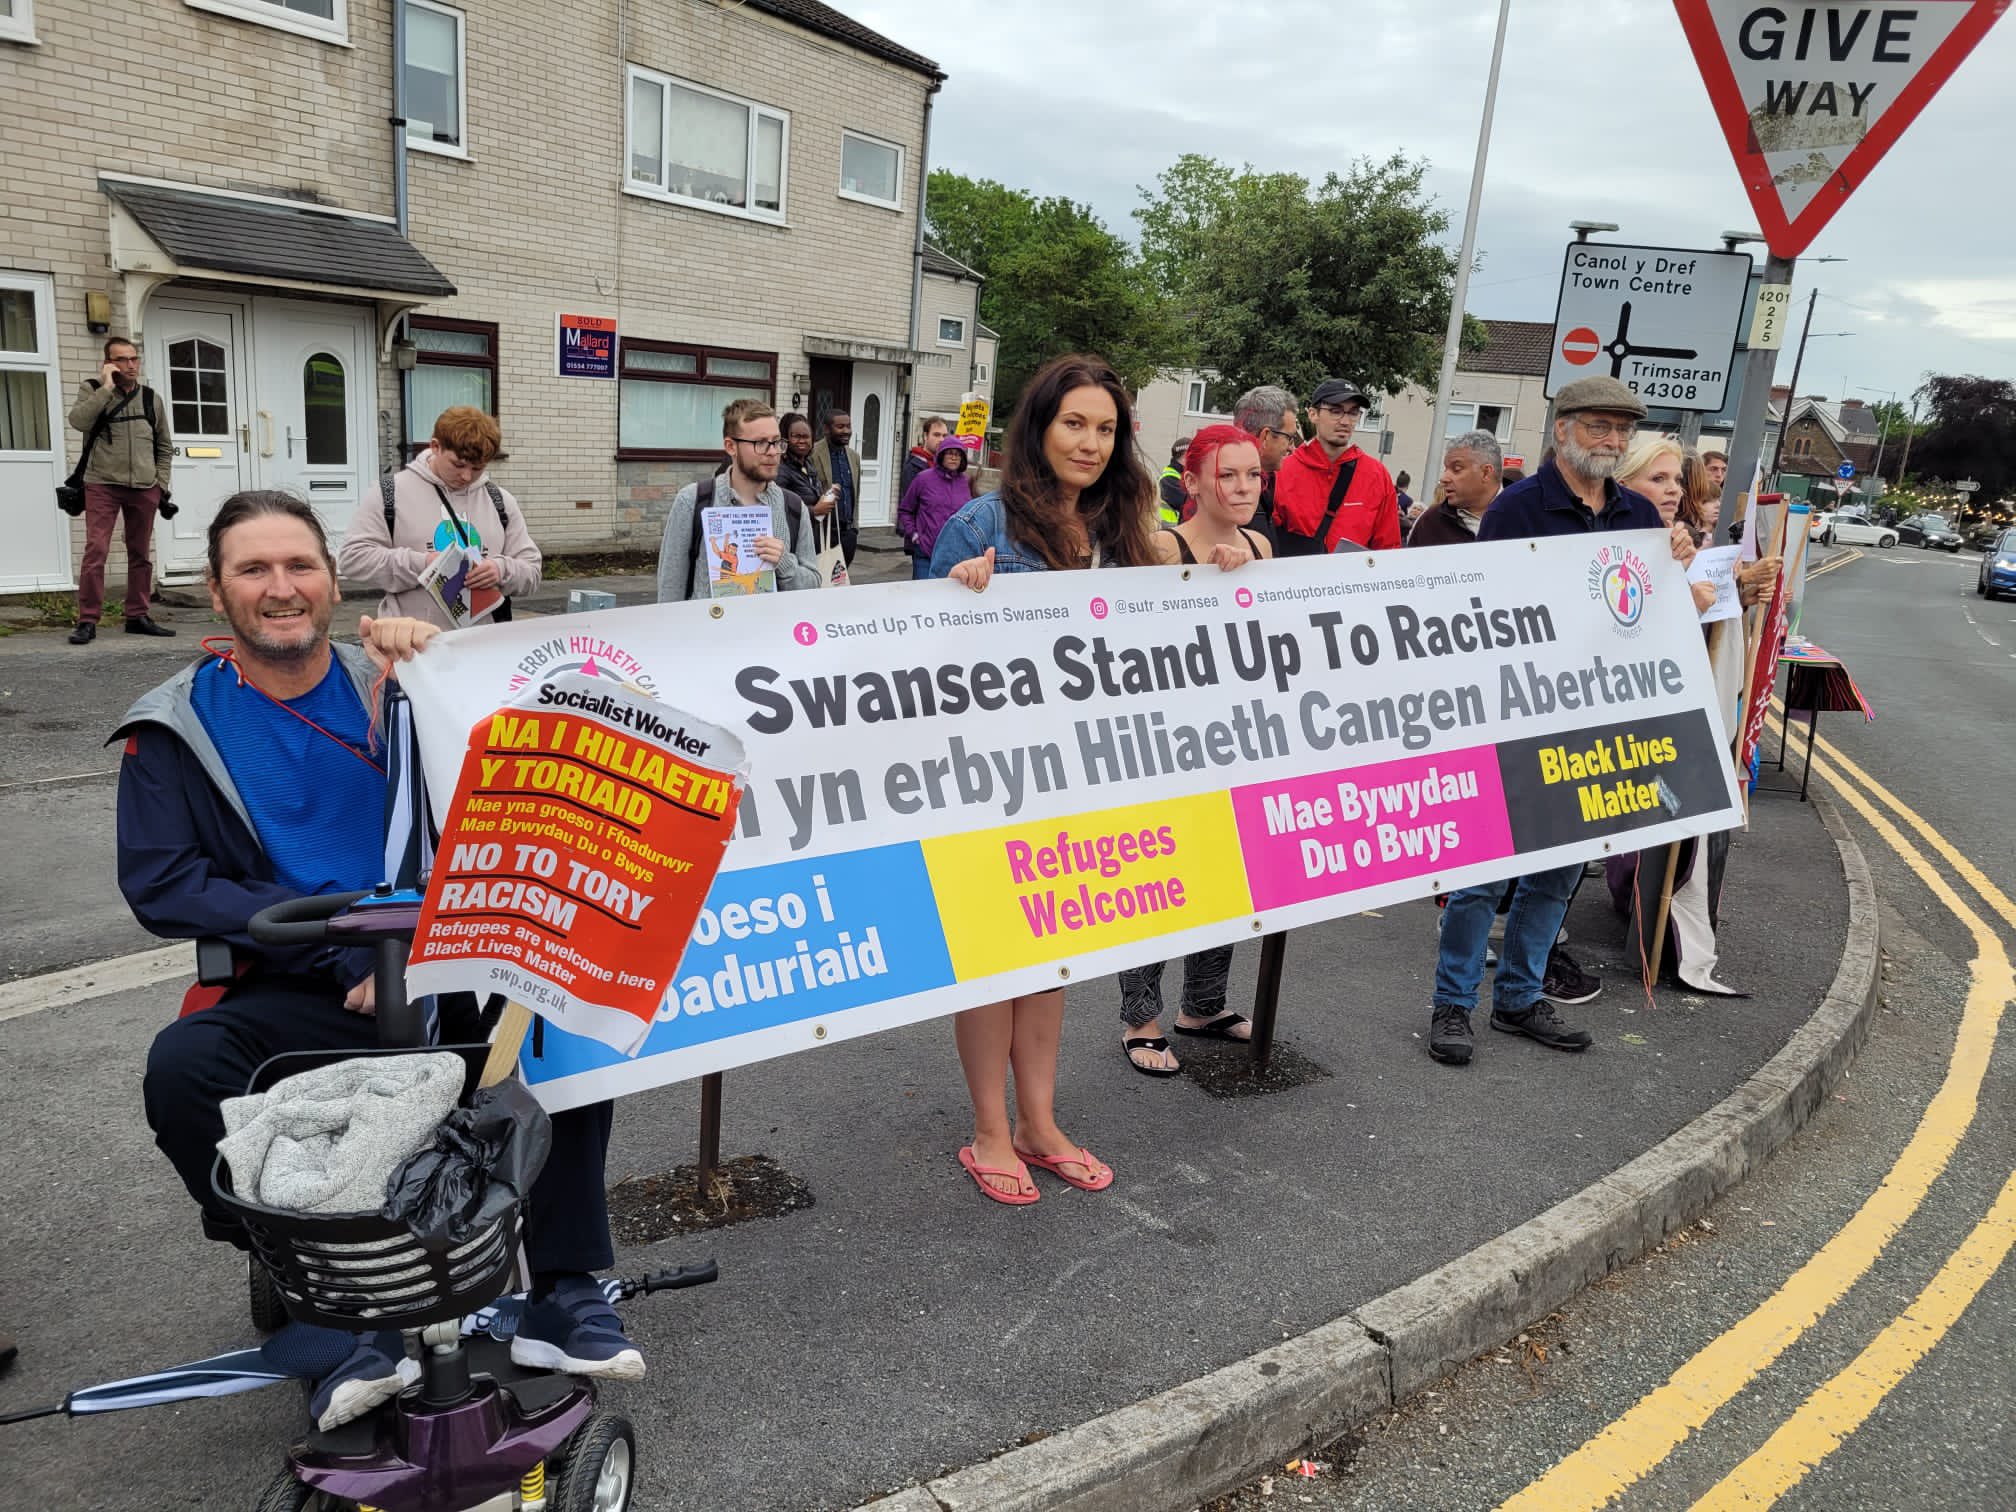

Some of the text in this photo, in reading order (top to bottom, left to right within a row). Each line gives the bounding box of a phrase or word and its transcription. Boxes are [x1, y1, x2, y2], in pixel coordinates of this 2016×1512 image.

[1738, 7, 1918, 64] GIVE
[1765, 79, 1877, 118] WAY
[1571, 273, 1693, 296] Town Centre
[1574, 252, 1697, 276] Canol y Dref
[577, 316, 603, 326] SOLD
[1764, 319, 1773, 330] 2
[1767, 306, 1776, 317] 2
[566, 327, 609, 349] Mallard
[1761, 332, 1771, 343] 5
[1632, 361, 1722, 384] Trimsaran
[1643, 382, 1697, 400] 4308
[1257, 570, 1485, 605] standuptoracismswansea@gmail.com
[1587, 545, 1653, 600] STAND UP TO RACISM
[825, 604, 1070, 640] Stand Up To Racism Swansea
[1114, 595, 1219, 615] @sutr_swansea
[518, 637, 567, 676] ERBYN
[570, 636, 643, 676] HILIAETH
[735, 597, 1557, 735] Swansea Stand Up To Racism
[487, 715, 539, 749] NA
[551, 721, 567, 750] I
[574, 727, 730, 814] HILIAETH
[775, 768, 867, 852] yn
[883, 735, 1068, 817] erbyn
[1074, 698, 1290, 787] Hiliaeth
[1299, 682, 1487, 750] Cangen
[1499, 655, 1685, 721] Abertawe
[1539, 732, 1677, 786] Black Lives
[479, 759, 652, 826] Y TORIAID
[1262, 767, 1479, 836] Mae Bywydau
[1577, 778, 1662, 824] Matter
[460, 817, 655, 883] Mae Bywydau Du o Bwys
[466, 798, 694, 874] Mae yna groeso i Ffoadurwyr
[1005, 823, 1177, 886] Refugees
[1300, 817, 1461, 880] Du o Bwys
[450, 843, 654, 922] NO TO TORY
[438, 883, 578, 931] RACISM
[692, 874, 834, 946] oeso i
[1018, 877, 1186, 938] Welcome
[423, 938, 577, 985] Black Lives Matter
[428, 922, 657, 991] Refugees are welcome here
[655, 926, 888, 1023] oaduriaid
[489, 967, 568, 1014] swp.org.uk
